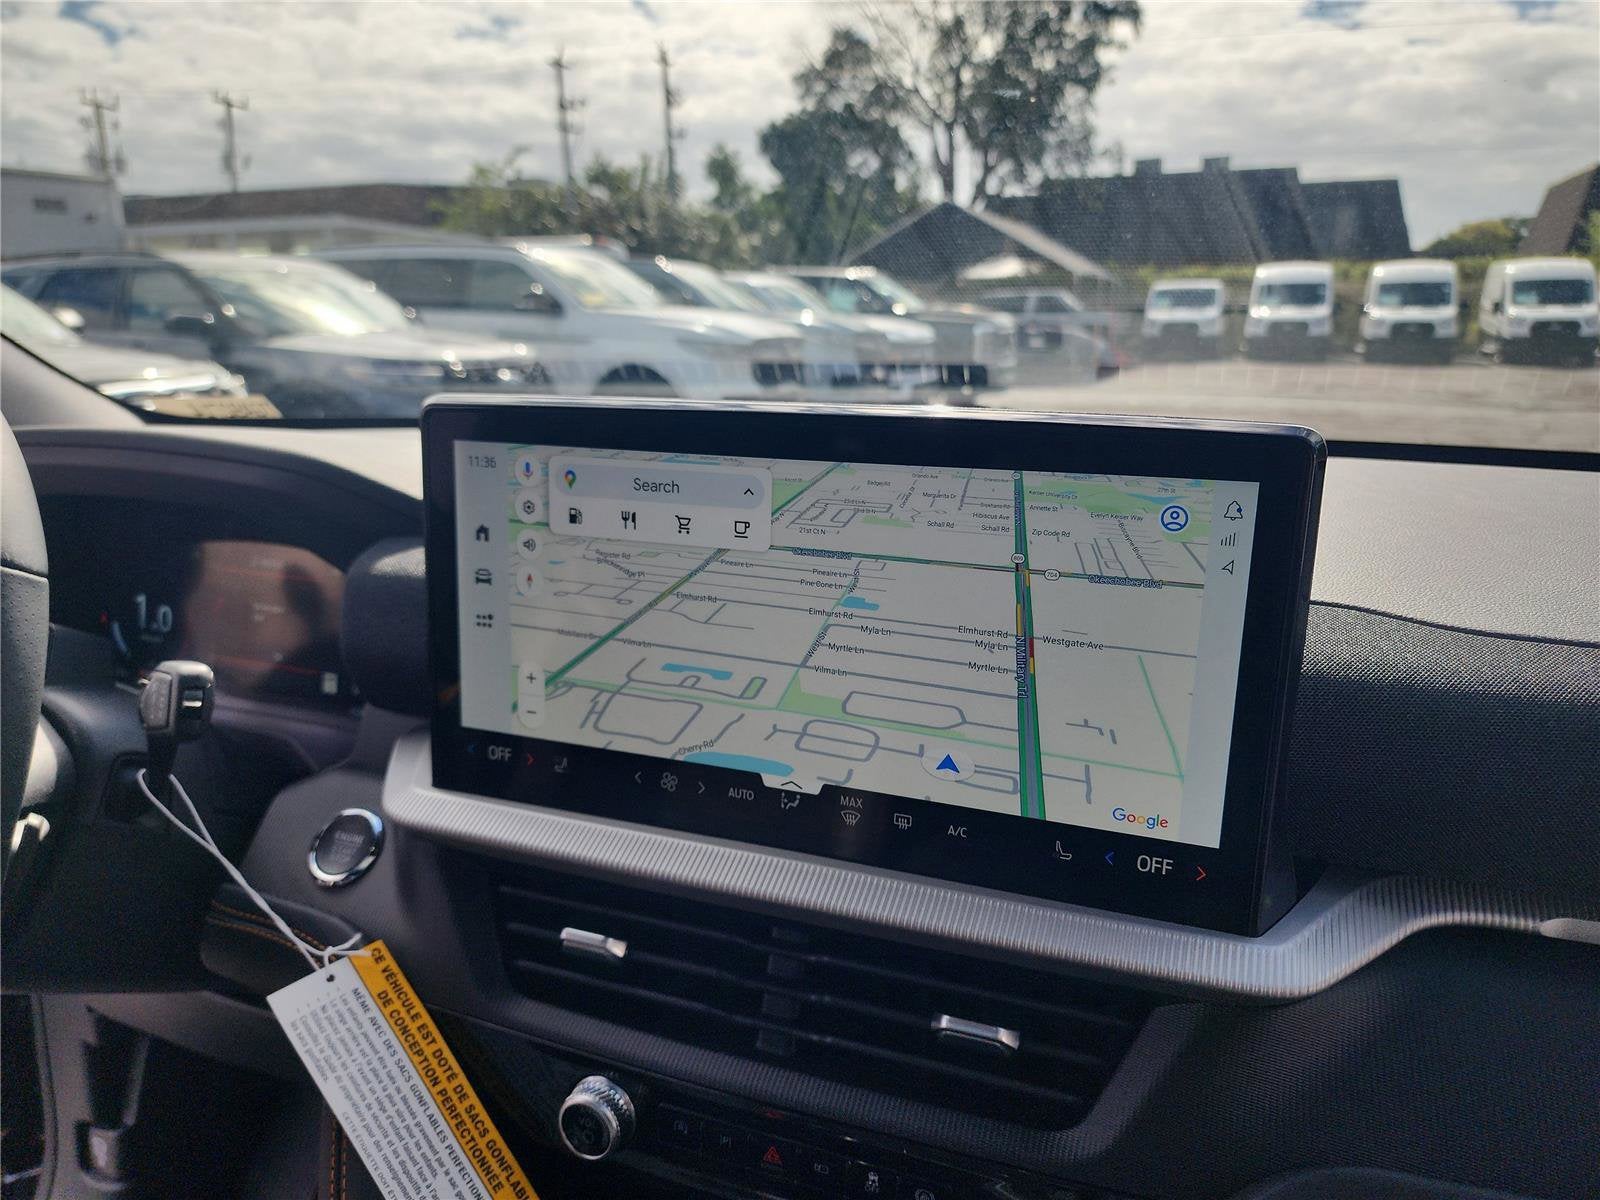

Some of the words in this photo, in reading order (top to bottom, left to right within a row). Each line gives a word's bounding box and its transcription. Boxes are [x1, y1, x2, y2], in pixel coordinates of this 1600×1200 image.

[467, 456, 497, 469] 11:36
[633, 476, 680, 494] Search
[1029, 504, 1051, 512] Annette
[972, 512, 995, 520] Hibiscus
[996, 513, 1010, 521] Ave
[1091, 512, 1108, 521] Evelyn
[1131, 514, 1144, 523] Way
[927, 520, 946, 528] Schall
[946, 521, 955, 529] Rd
[1001, 525, 1010, 533] Rd
[799, 527, 813, 535] 21st
[821, 528, 826, 536] N
[1032, 529, 1043, 538] Zip
[1043, 529, 1061, 537] Code
[1061, 530, 1071, 538] Rd
[1119, 523, 1136, 549] Biscayne
[1133, 546, 1143, 560] Blvd
[812, 568, 838, 577] Pineaire
[800, 579, 815, 587] Pine
[816, 580, 834, 589] Cone
[1088, 575, 1142, 588] Okeechobee
[1143, 579, 1163, 589] Blvd
[676, 592, 706, 602] Elmhurst
[808, 607, 842, 619] Elmhurst
[843, 612, 854, 620] Rd
[861, 625, 880, 637] Myla
[957, 625, 995, 637] Elmhurst
[996, 630, 1009, 639] Rd
[622, 639, 642, 648] Vilma
[806, 641, 821, 658] West
[817, 631, 827, 642] St
[974, 639, 996, 652] Myla
[997, 642, 1009, 651] Ln
[1015, 636, 1026, 644] N
[1042, 635, 1085, 649] Westgate
[1086, 640, 1104, 651] Ave
[828, 642, 854, 652] Myrtle
[854, 646, 865, 654] Ln
[814, 665, 836, 676] Vilma
[837, 669, 848, 677] Ln
[967, 661, 997, 673] Myrtle
[997, 665, 1009, 674] Ln
[1014, 646, 1028, 683] Military
[1018, 684, 1029, 699] Trl
[488, 744, 512, 762] OFF
[677, 742, 702, 756] Cherry
[702, 739, 714, 749] Rd
[728, 788, 755, 801] AUTO
[840, 795, 863, 809] MAX
[1111, 807, 1169, 830] Google
[947, 824, 968, 839] A/C
[1136, 854, 1174, 876] OFF
[371, 947, 386, 964] CE
[381, 964, 422, 1022] VÉHICULE
[416, 1022, 437, 1045] EST
[431, 1047, 458, 1083] DOTÉ
[452, 1083, 469, 1104] DE
[464, 1103, 489, 1138] SACS
[376, 989, 394, 1008] DE
[389, 1009, 441, 1087] CONCEPTION
[367, 1016, 386, 1038] AVEC
[382, 1038, 398, 1057] DES
[394, 1057, 413, 1083] SACS
[409, 1083, 448, 1144] GONFLABLES
[372, 1139, 383, 1152] des
